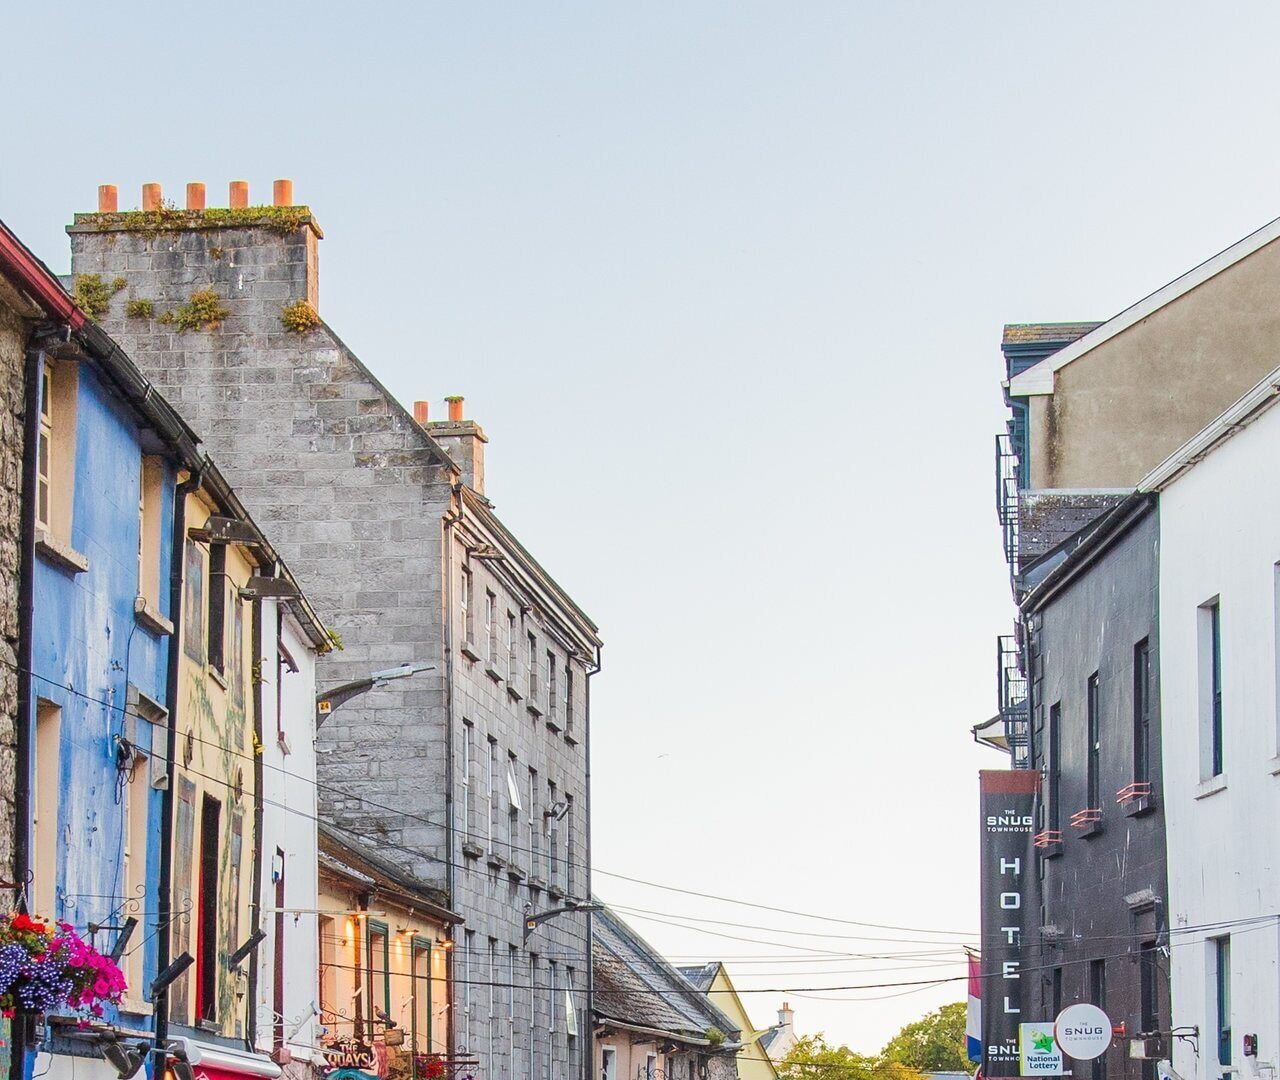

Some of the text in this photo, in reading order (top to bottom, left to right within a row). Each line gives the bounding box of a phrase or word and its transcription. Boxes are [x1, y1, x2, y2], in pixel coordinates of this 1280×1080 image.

[987, 816, 1033, 826] SNUG
[1000, 858, 1020, 1013] HOTEL
[1064, 1027, 1103, 1036] SNUG
[340, 1044, 358, 1054] THE
[988, 1046, 1020, 1054] SNU
[328, 1053, 369, 1068] QUAYS
[1029, 1062, 1059, 1070] Lottery
